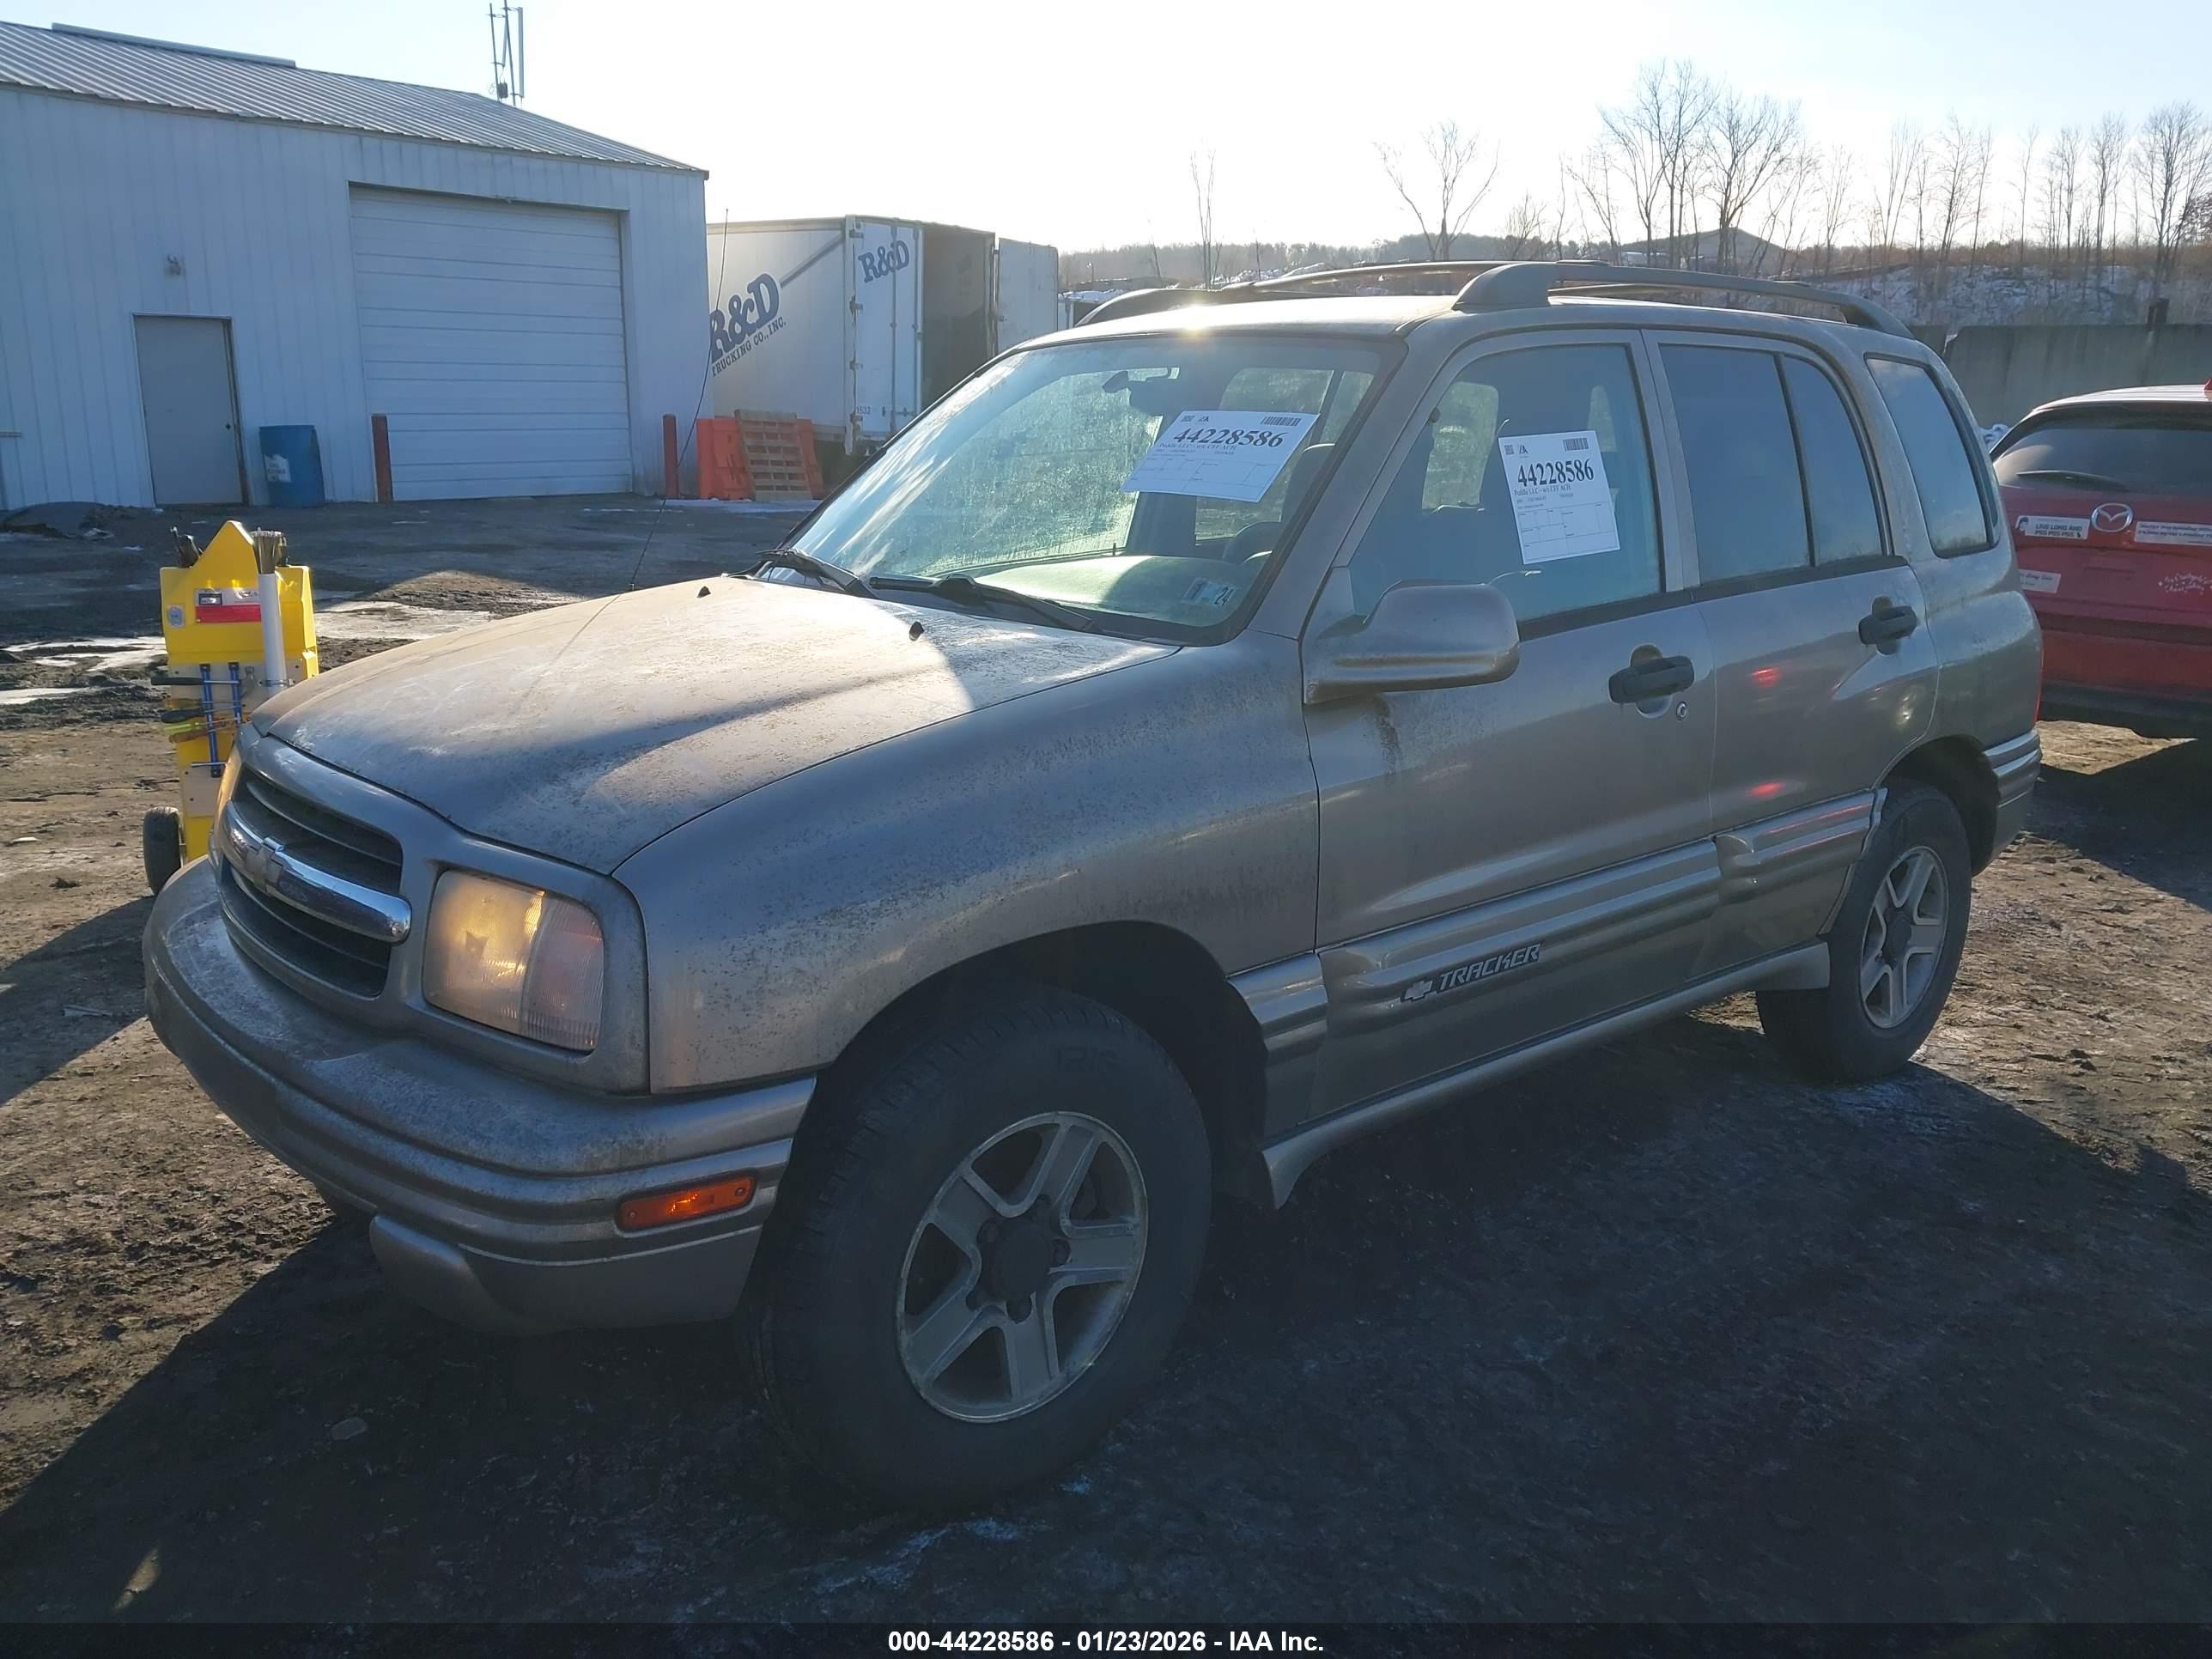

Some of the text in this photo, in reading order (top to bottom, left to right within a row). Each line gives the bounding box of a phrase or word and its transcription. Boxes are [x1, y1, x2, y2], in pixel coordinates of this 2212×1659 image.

[858, 240, 910, 283] R&D
[709, 273, 780, 363] R&D
[711, 341, 752, 377] TRUCKING
[1174, 428, 1290, 448] 44228586
[1517, 458, 1595, 487] 44228586
[1214, 586, 1235, 607] 24
[1439, 944, 1540, 991] TRACKER
